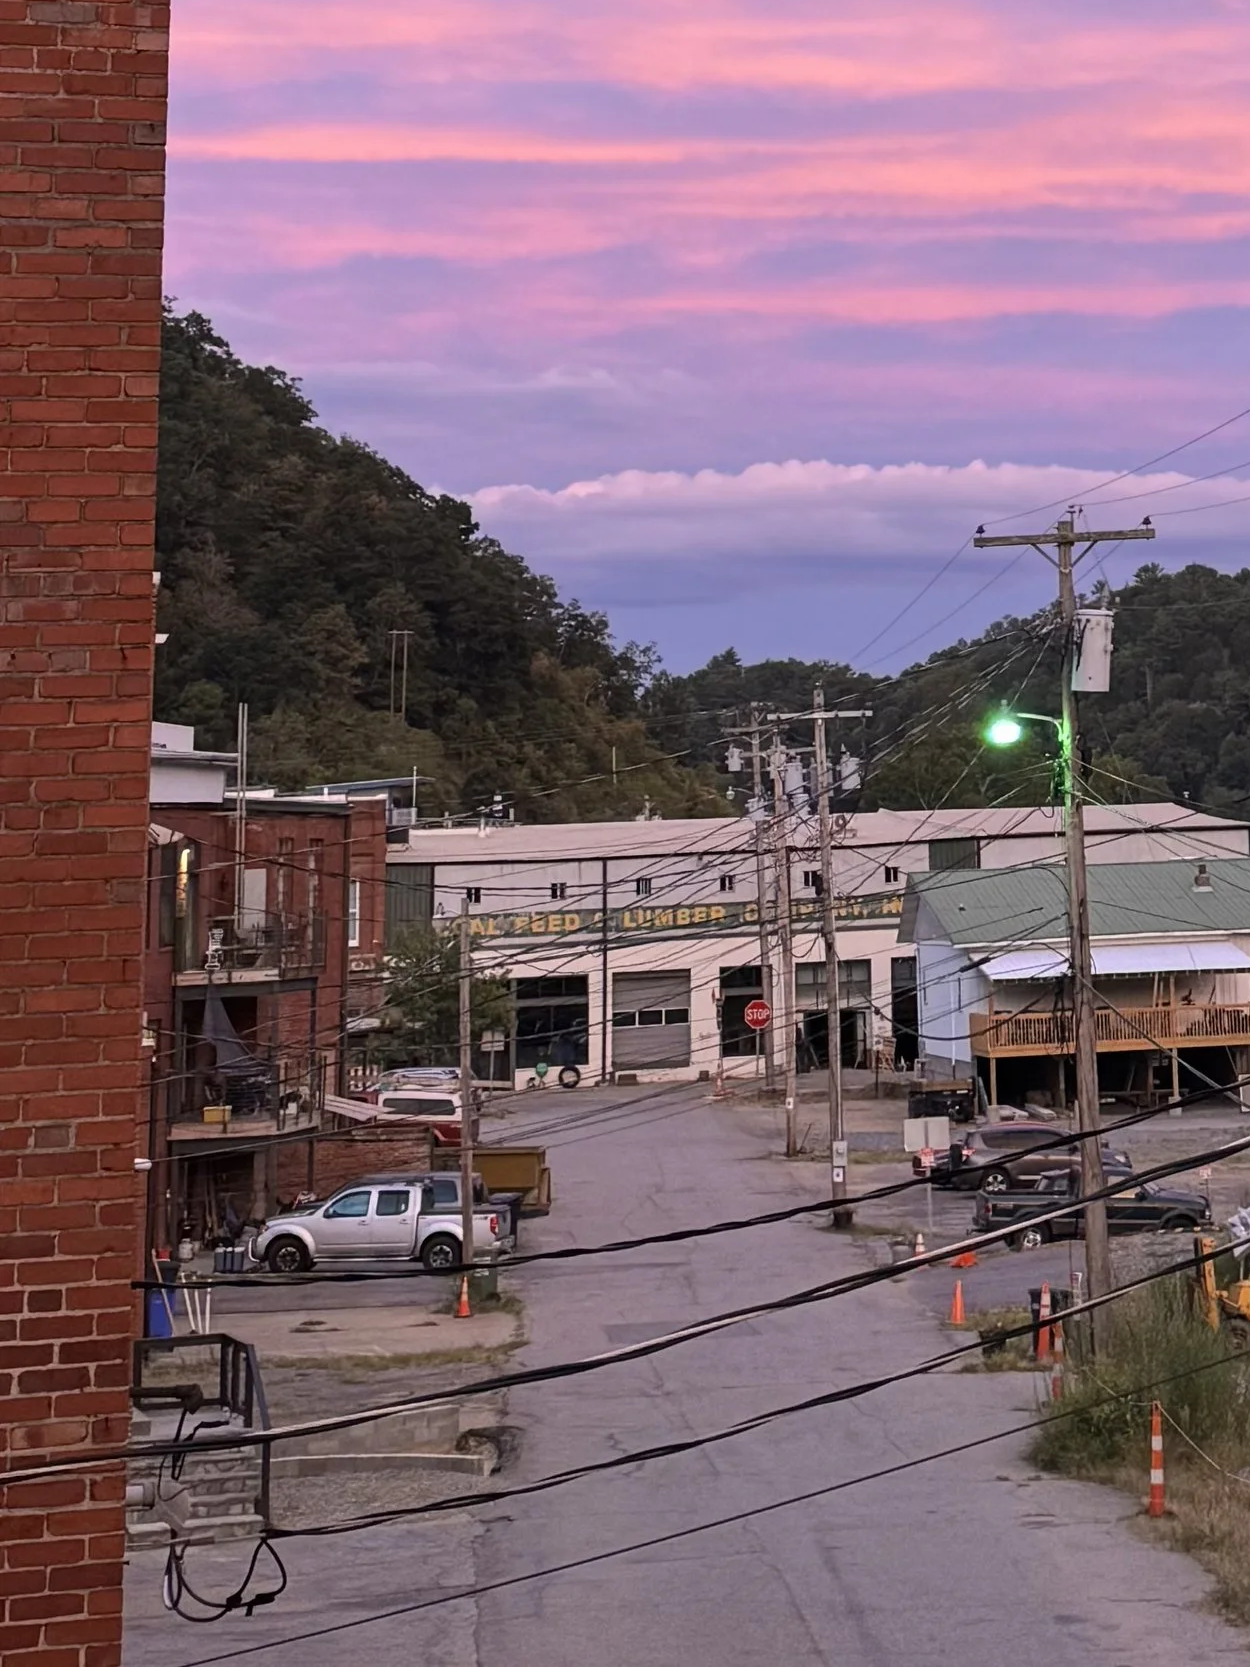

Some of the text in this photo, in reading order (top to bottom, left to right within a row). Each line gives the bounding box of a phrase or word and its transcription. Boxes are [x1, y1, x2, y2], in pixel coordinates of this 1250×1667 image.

[514, 913, 581, 934] FEED
[623, 905, 727, 929] LUMBER
[746, 1008, 770, 1021] STOP
